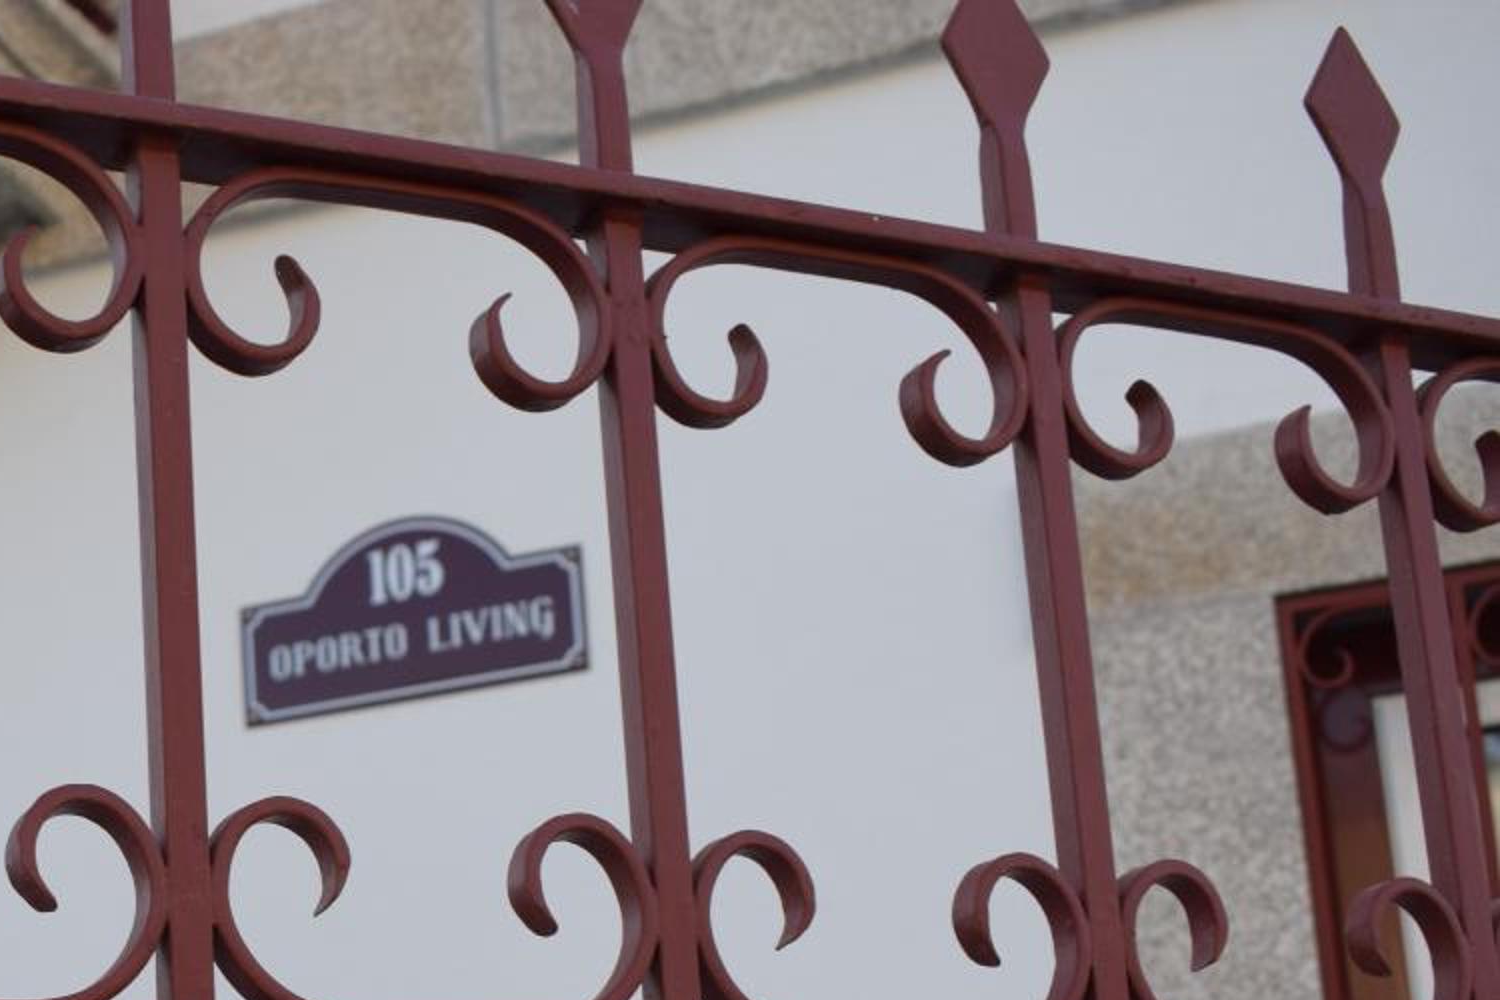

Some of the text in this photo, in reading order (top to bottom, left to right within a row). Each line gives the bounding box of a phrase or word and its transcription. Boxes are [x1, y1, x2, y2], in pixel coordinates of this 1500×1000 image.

[367, 538, 445, 606] 105
[268, 596, 555, 682] OPORTO LIVING
